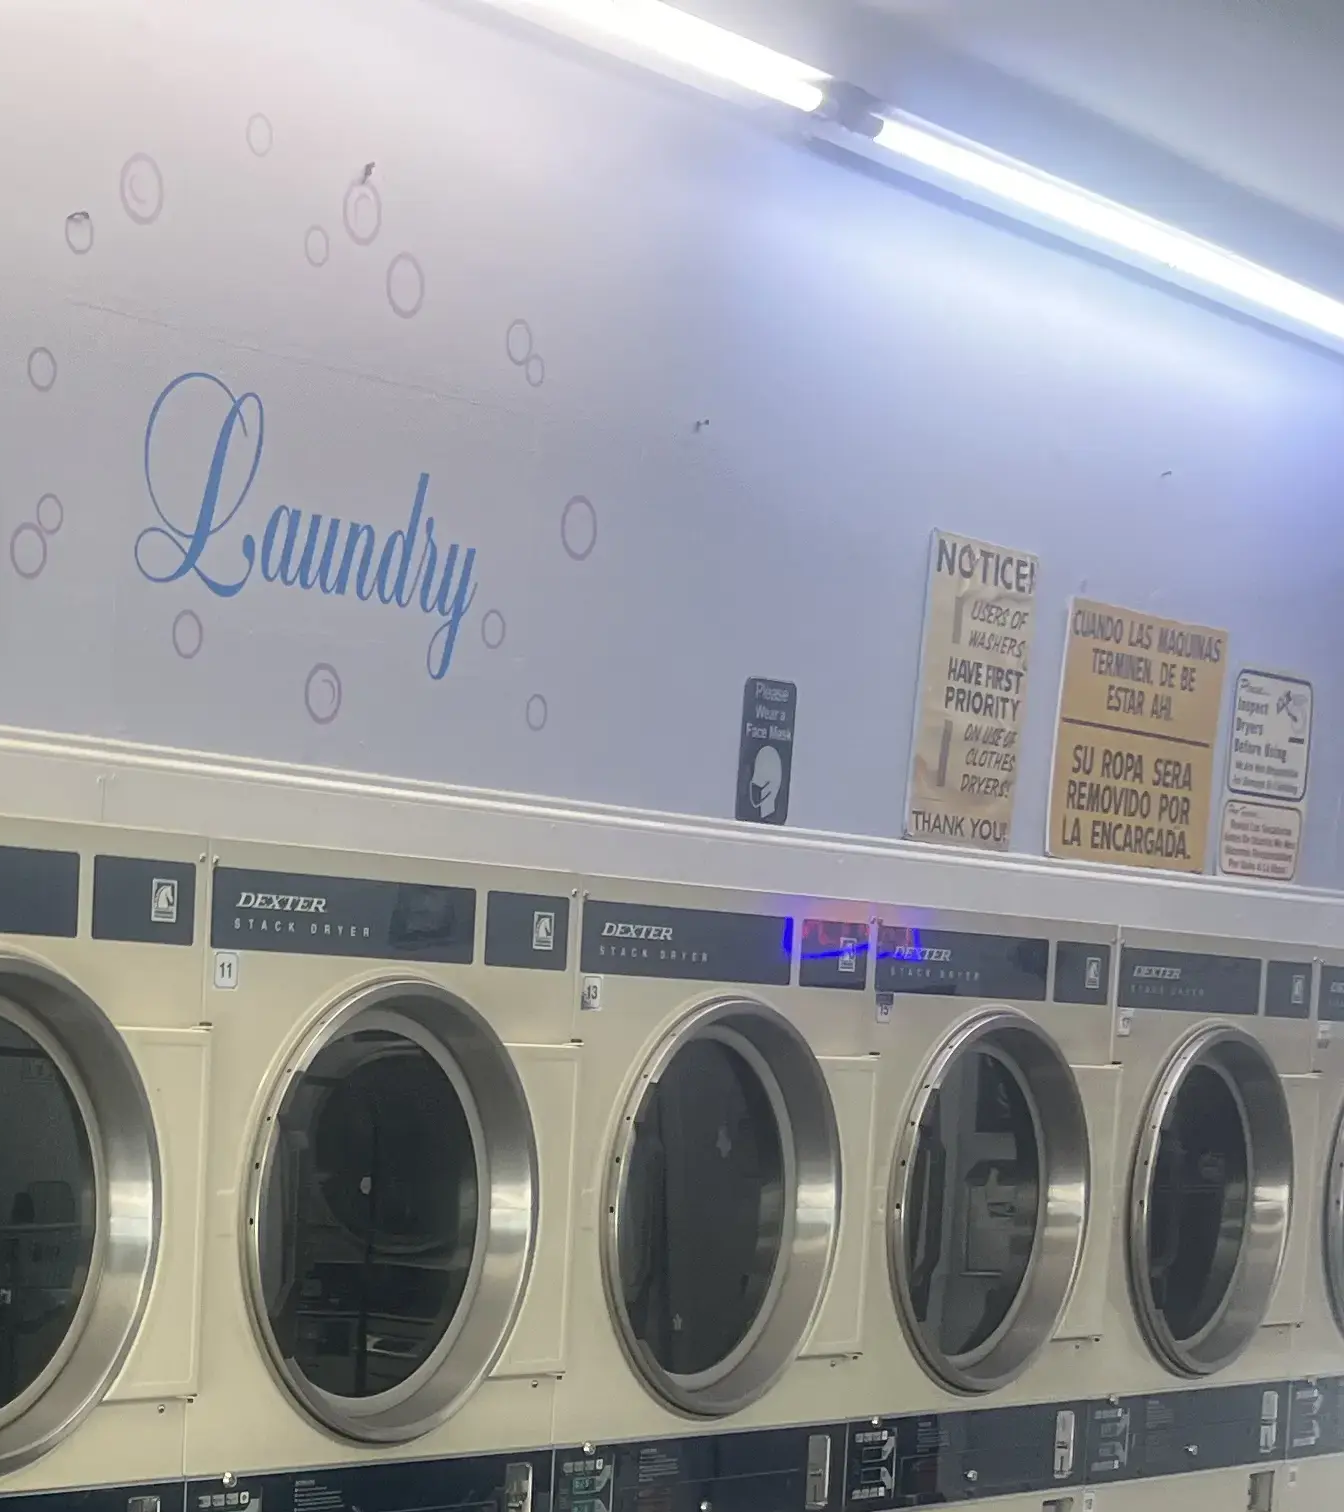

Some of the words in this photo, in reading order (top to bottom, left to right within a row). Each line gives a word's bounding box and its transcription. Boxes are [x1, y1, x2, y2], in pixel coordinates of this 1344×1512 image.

[133, 371, 479, 681] Laundry
[971, 600, 1010, 627] USERS
[1011, 610, 1029, 630] OF
[1072, 609, 1124, 644] CUANDO
[1128, 620, 1153, 650] LAS
[947, 655, 983, 686] HAVE
[985, 664, 1024, 694] FIRST
[1159, 662, 1177, 688] DE
[1180, 665, 1197, 692] BE
[755, 681, 789, 702] Please
[944, 686, 1022, 721] PRIORITY
[1106, 684, 1145, 716] ESTAR
[755, 704, 778, 721] Wear
[745, 722, 768, 739] Face
[769, 725, 792, 742] Mask
[964, 723, 979, 742] ON
[965, 748, 1016, 772] CLOTHES
[1071, 744, 1095, 776] SU
[1100, 748, 1144, 784] ROPA
[1151, 758, 1193, 791] SERA
[1066, 779, 1151, 819] REMOVIDO
[1158, 793, 1190, 825] POR
[912, 810, 964, 837] THANK
[1062, 815, 1081, 846] LA
[1090, 820, 1192, 860] ENCARGADA.
[235, 892, 327, 914] DEXTER
[234, 918, 295, 933] STACK
[601, 922, 673, 940] DEXTER
[892, 945, 952, 961] DEXTER
[219, 962, 233, 979] 11
[587, 985, 598, 1000] 13
